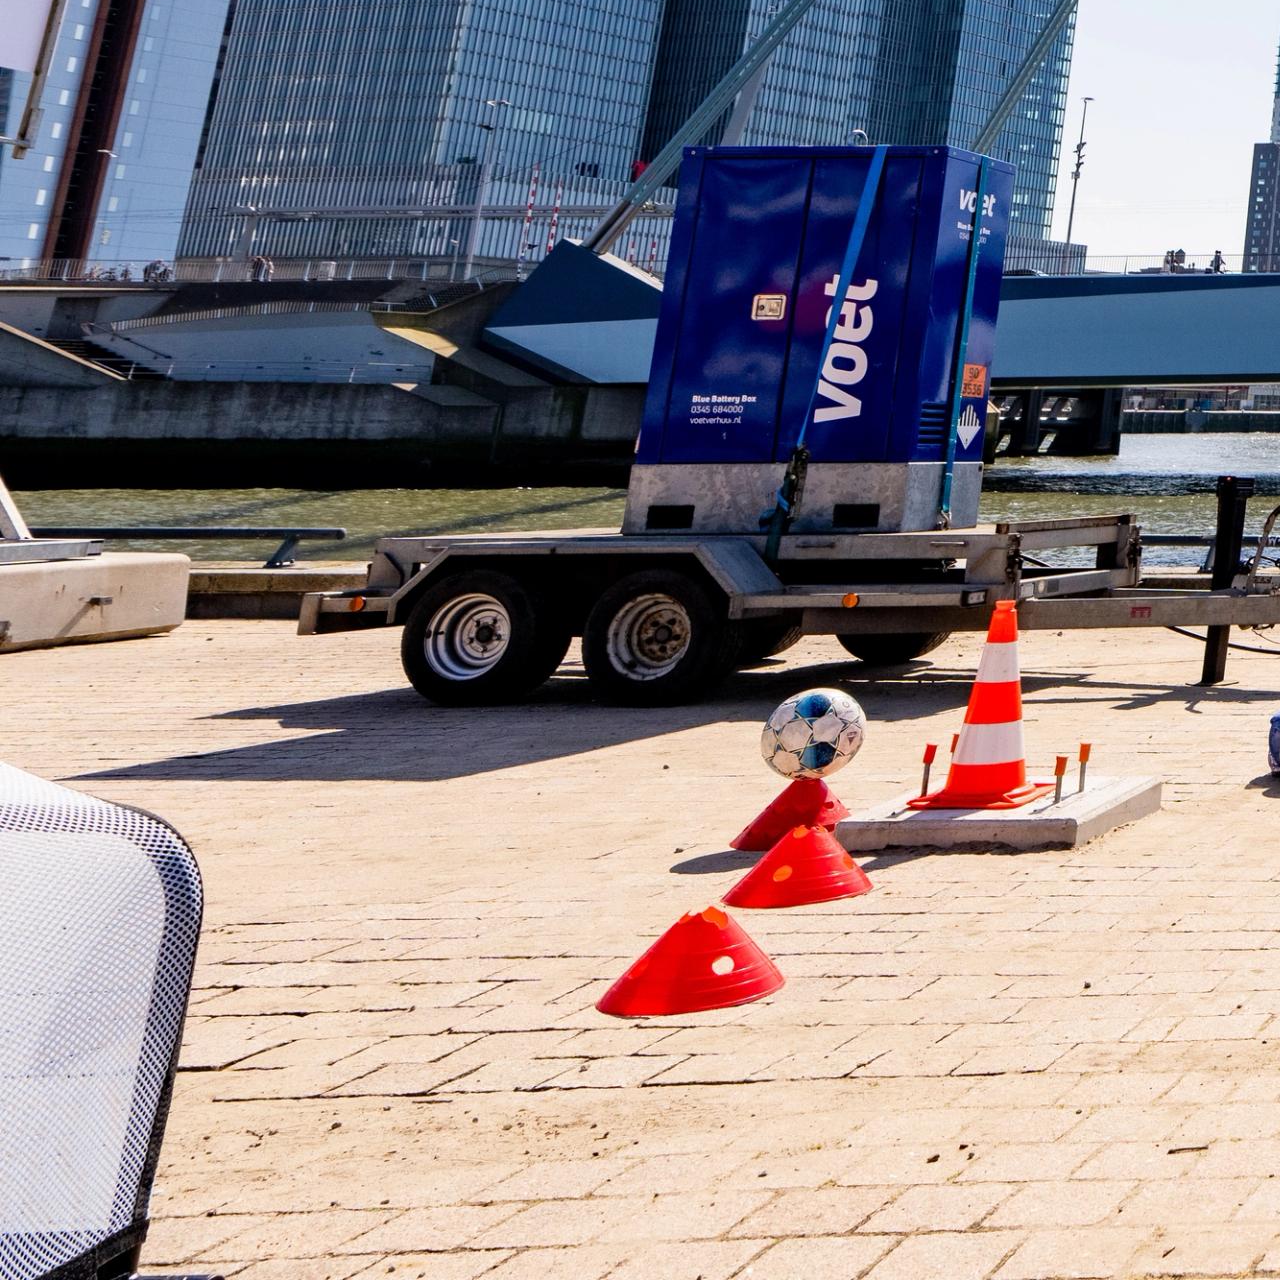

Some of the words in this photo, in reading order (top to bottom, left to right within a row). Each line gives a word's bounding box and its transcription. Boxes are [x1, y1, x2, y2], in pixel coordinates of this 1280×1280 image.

[814, 274, 878, 423] voet
[692, 395, 710, 403] Blue
[711, 395, 740, 404] Battery
[741, 394, 757, 402] Box
[691, 405, 711, 413] 0345
[712, 405, 744, 413] 684000
